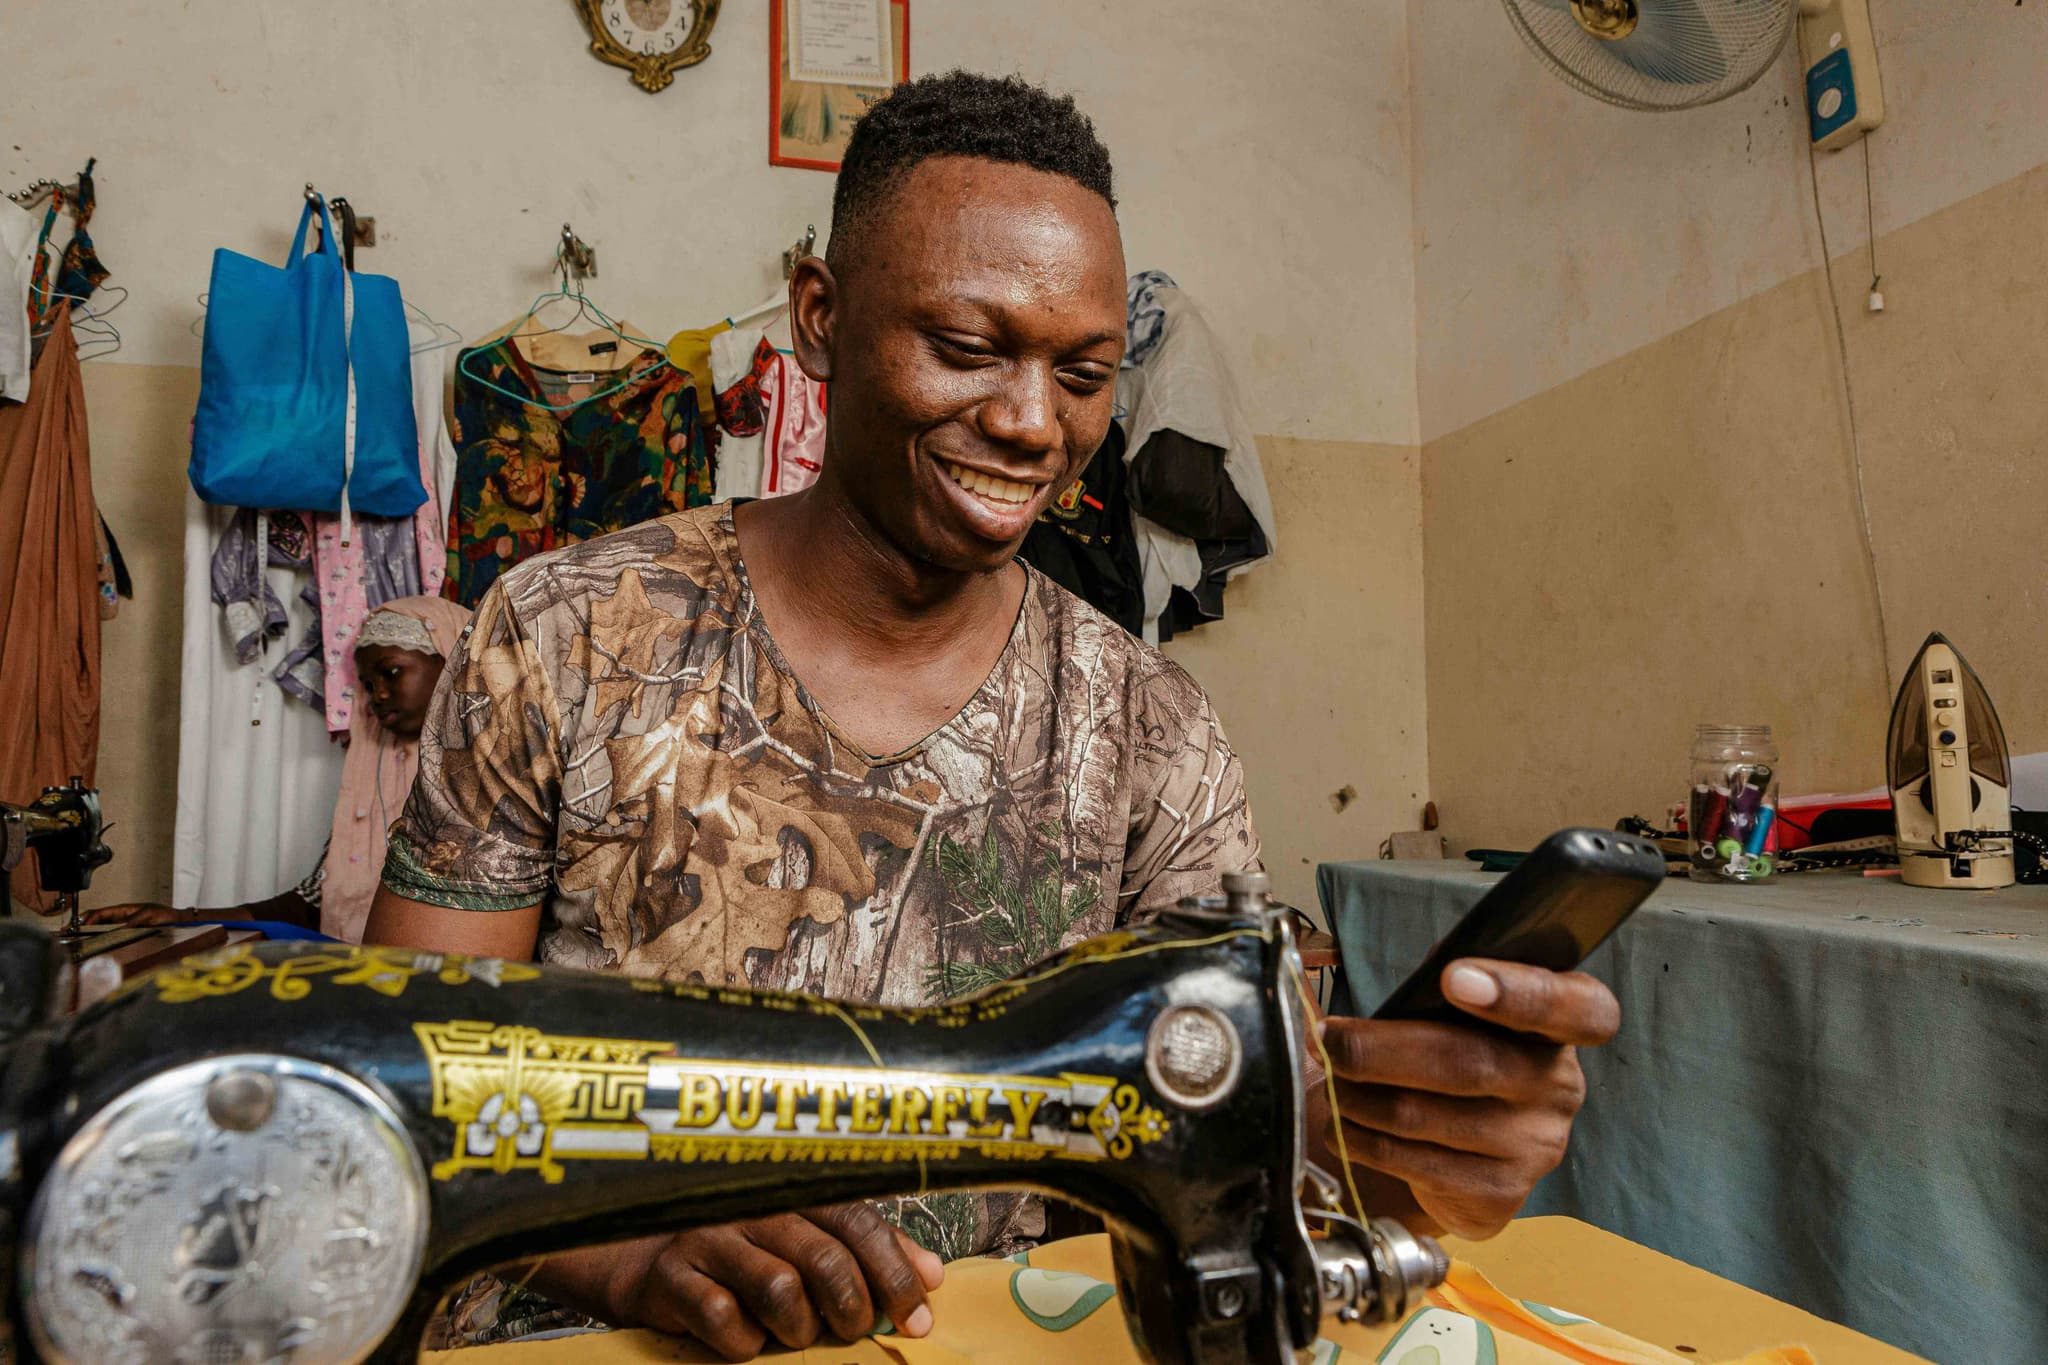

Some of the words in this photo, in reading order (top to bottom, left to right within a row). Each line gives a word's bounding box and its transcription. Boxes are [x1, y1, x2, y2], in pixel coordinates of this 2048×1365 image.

[610, 12, 621, 28] 8
[675, 16, 686, 31] 4
[623, 30, 633, 45] 7
[664, 32, 675, 48] 5
[644, 40, 656, 55] 6
[675, 1072, 1047, 1140] BUTTERFLY
